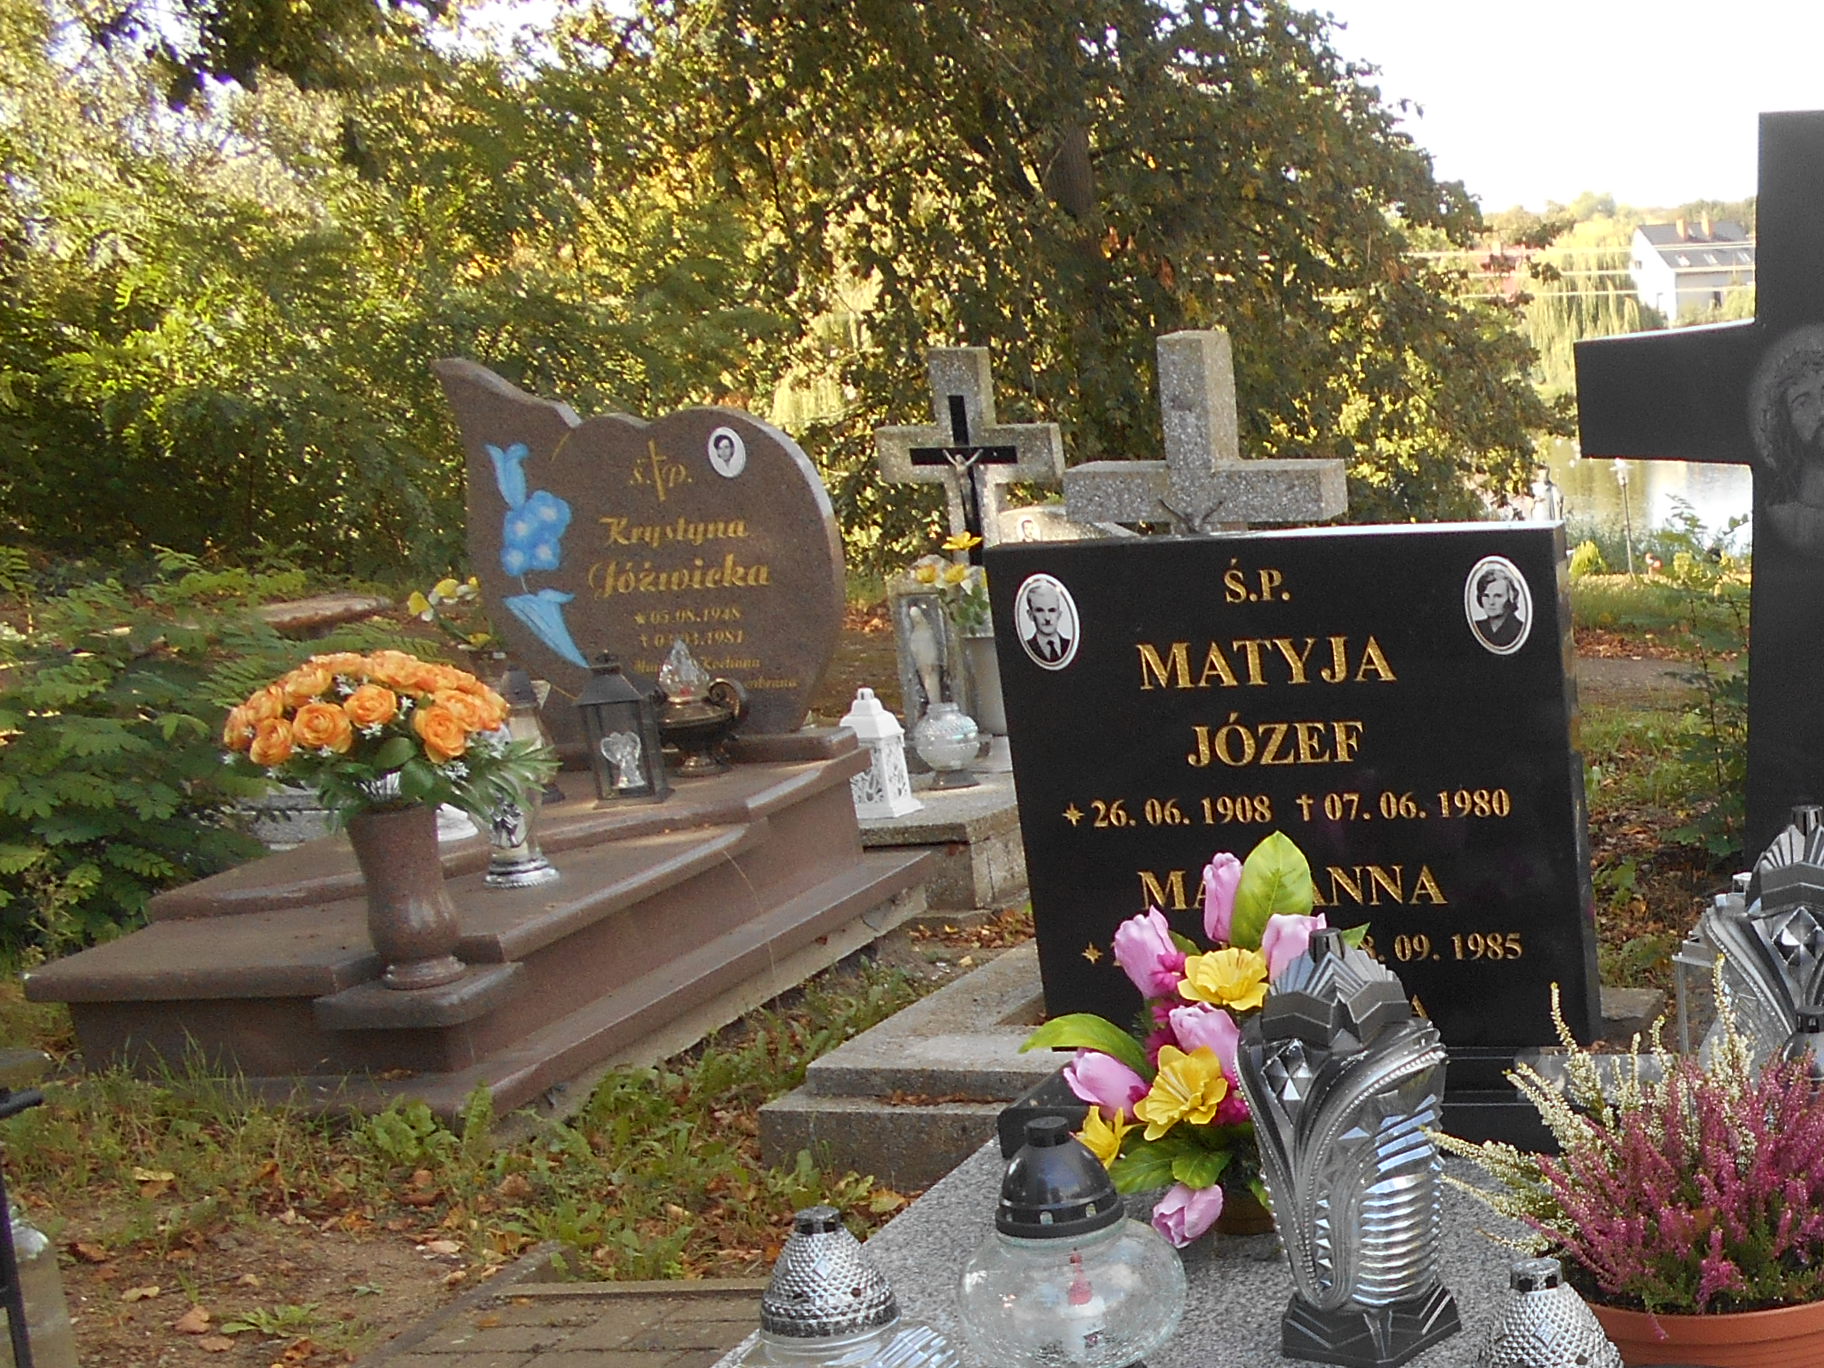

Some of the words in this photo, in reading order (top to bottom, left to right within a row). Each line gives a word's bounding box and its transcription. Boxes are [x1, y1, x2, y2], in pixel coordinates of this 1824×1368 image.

[599, 517, 749, 548] Krystyna
[1224, 559, 1292, 604] Ś.P.
[1137, 636, 1398, 691] MATYJA
[1187, 713, 1365, 768] JÓZEF
[1201, 795, 1273, 825] 1908
[1438, 788, 1511, 819] 1980
[1452, 932, 1523, 961] 1985
